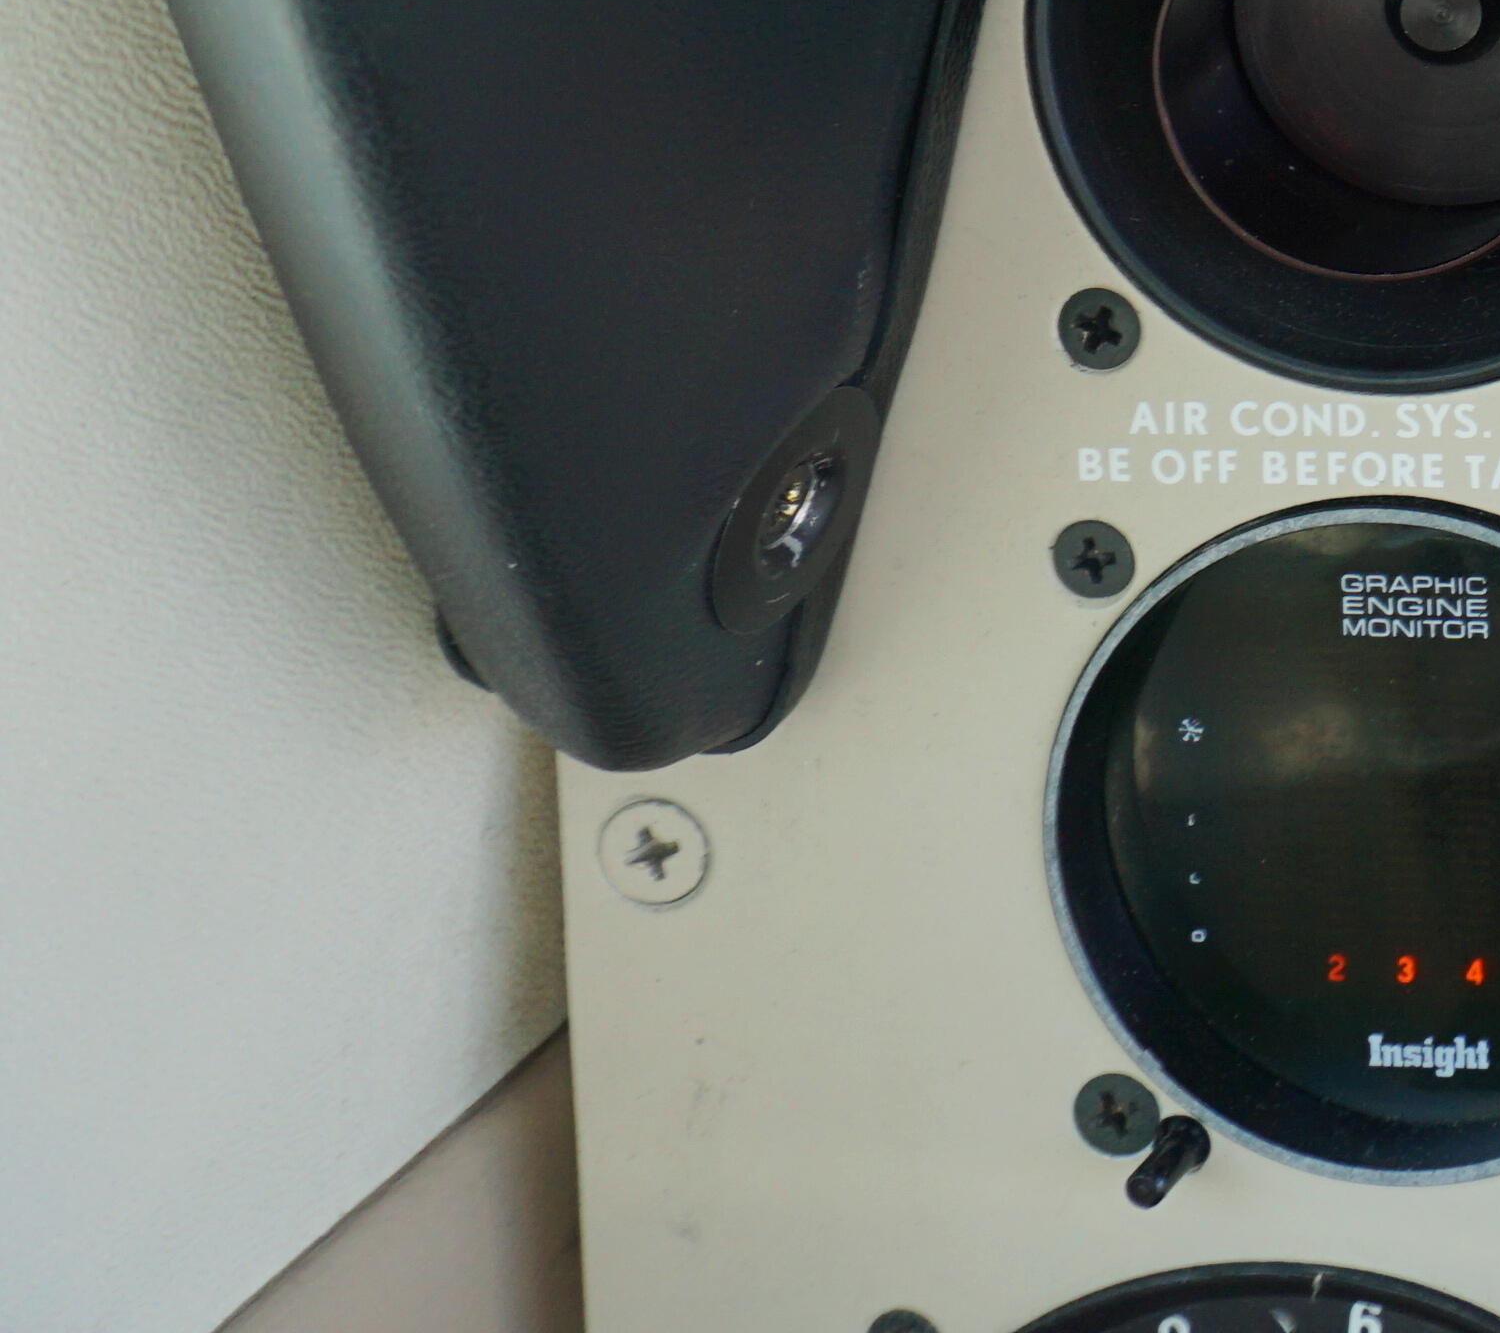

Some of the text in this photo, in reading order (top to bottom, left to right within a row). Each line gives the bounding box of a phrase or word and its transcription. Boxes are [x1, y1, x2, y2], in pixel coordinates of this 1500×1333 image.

[1128, 403, 1208, 438] AIR
[1229, 401, 1381, 440] COND.
[1395, 403, 1494, 440] SYS.
[1077, 447, 1132, 484] BE
[1150, 448, 1240, 486] OFF
[1261, 451, 1446, 490] BEFORE
[1339, 573, 1488, 596] GRAPHIC
[1340, 595, 1488, 618] ENGINE
[1340, 618, 1490, 641] MONITOR
[1327, 955, 1348, 984] 2
[1395, 956, 1416, 986] 3
[1464, 957, 1486, 988] 4
[1366, 1033, 1491, 1078] Insight
